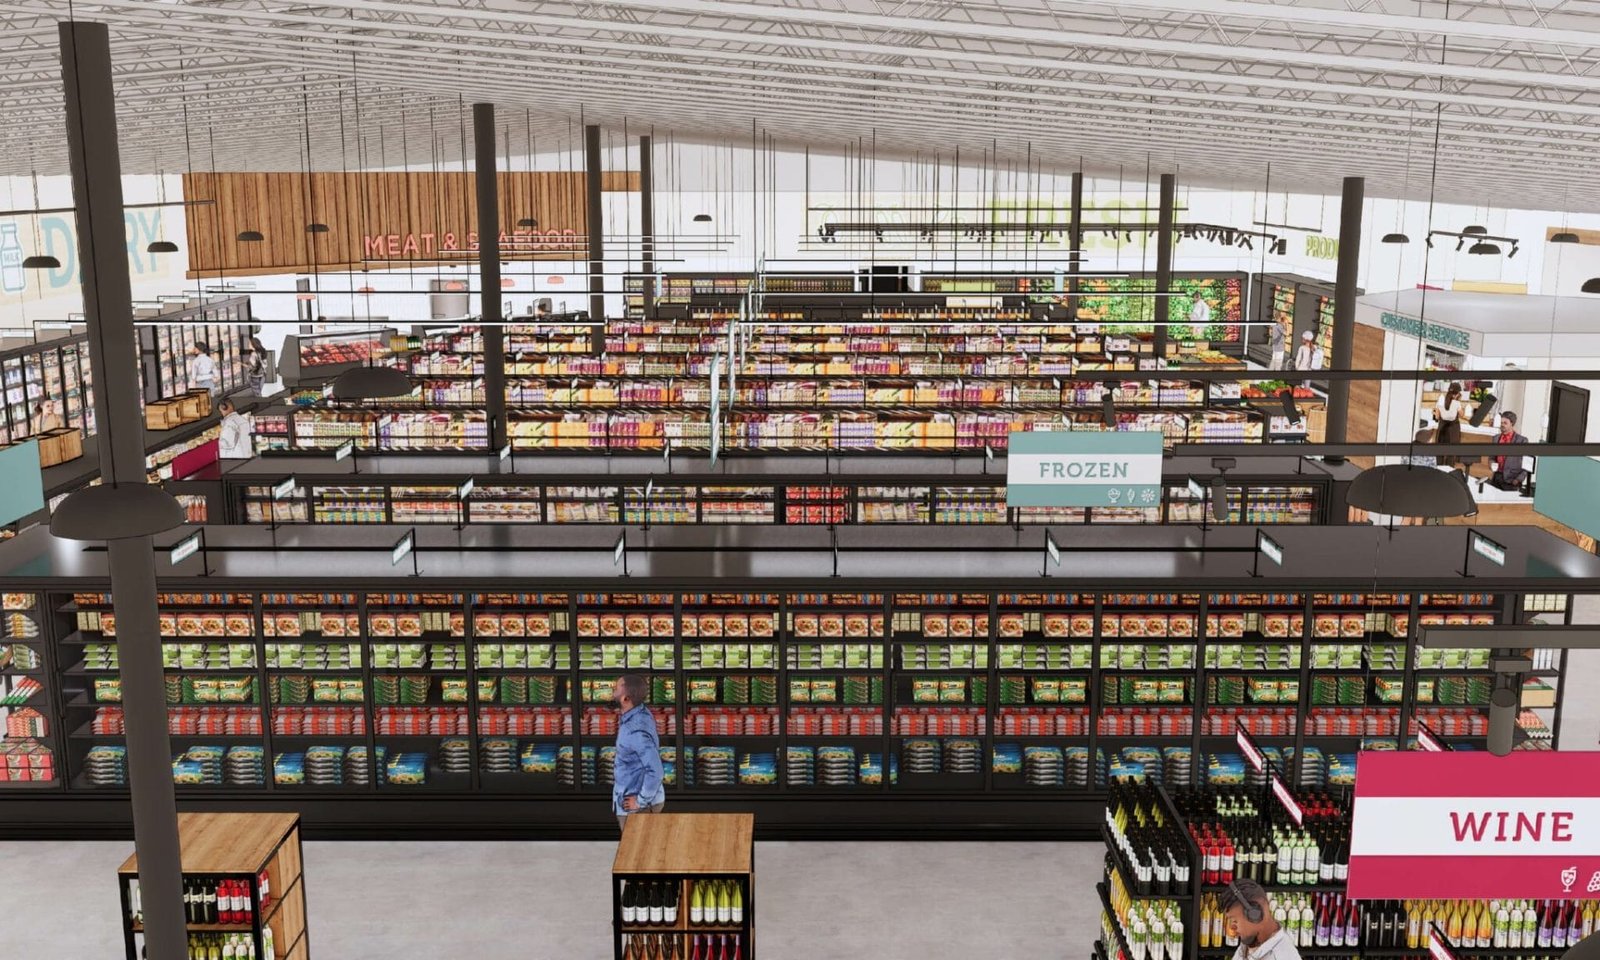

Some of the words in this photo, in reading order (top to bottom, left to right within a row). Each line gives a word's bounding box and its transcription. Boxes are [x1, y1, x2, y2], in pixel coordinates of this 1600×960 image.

[364, 233, 434, 256] MEAT
[443, 232, 458, 250] &
[467, 228, 577, 250] SAFOOD
[1380, 312, 1427, 338] CUSTOMER
[1428, 323, 1470, 350] SERVICE
[1039, 462, 1129, 478] FROZEN
[1449, 811, 1574, 842] WINE
